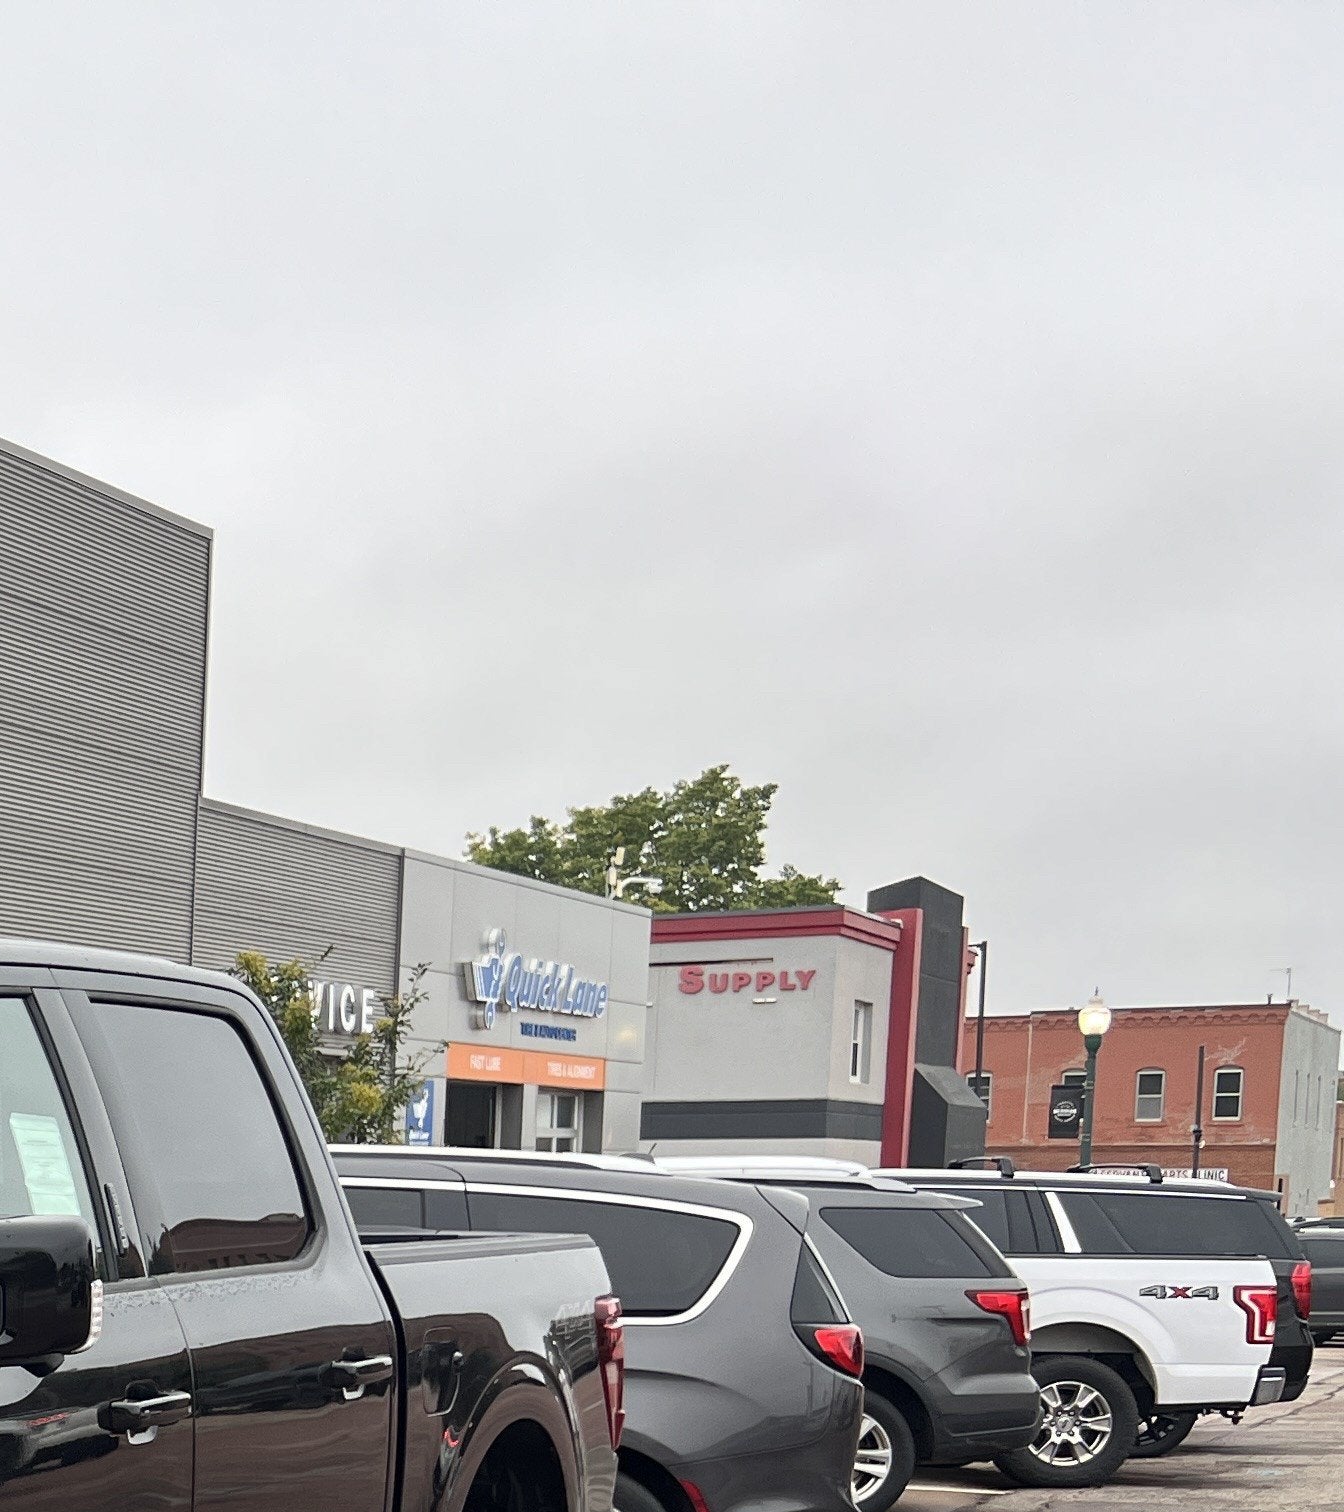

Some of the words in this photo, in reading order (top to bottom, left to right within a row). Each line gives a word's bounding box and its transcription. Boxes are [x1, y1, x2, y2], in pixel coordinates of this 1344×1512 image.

[505, 952, 560, 1013] Quick
[559, 963, 608, 1019] Lane
[678, 965, 817, 995] SUPPLY
[1197, 1167, 1225, 1182] LINIC
